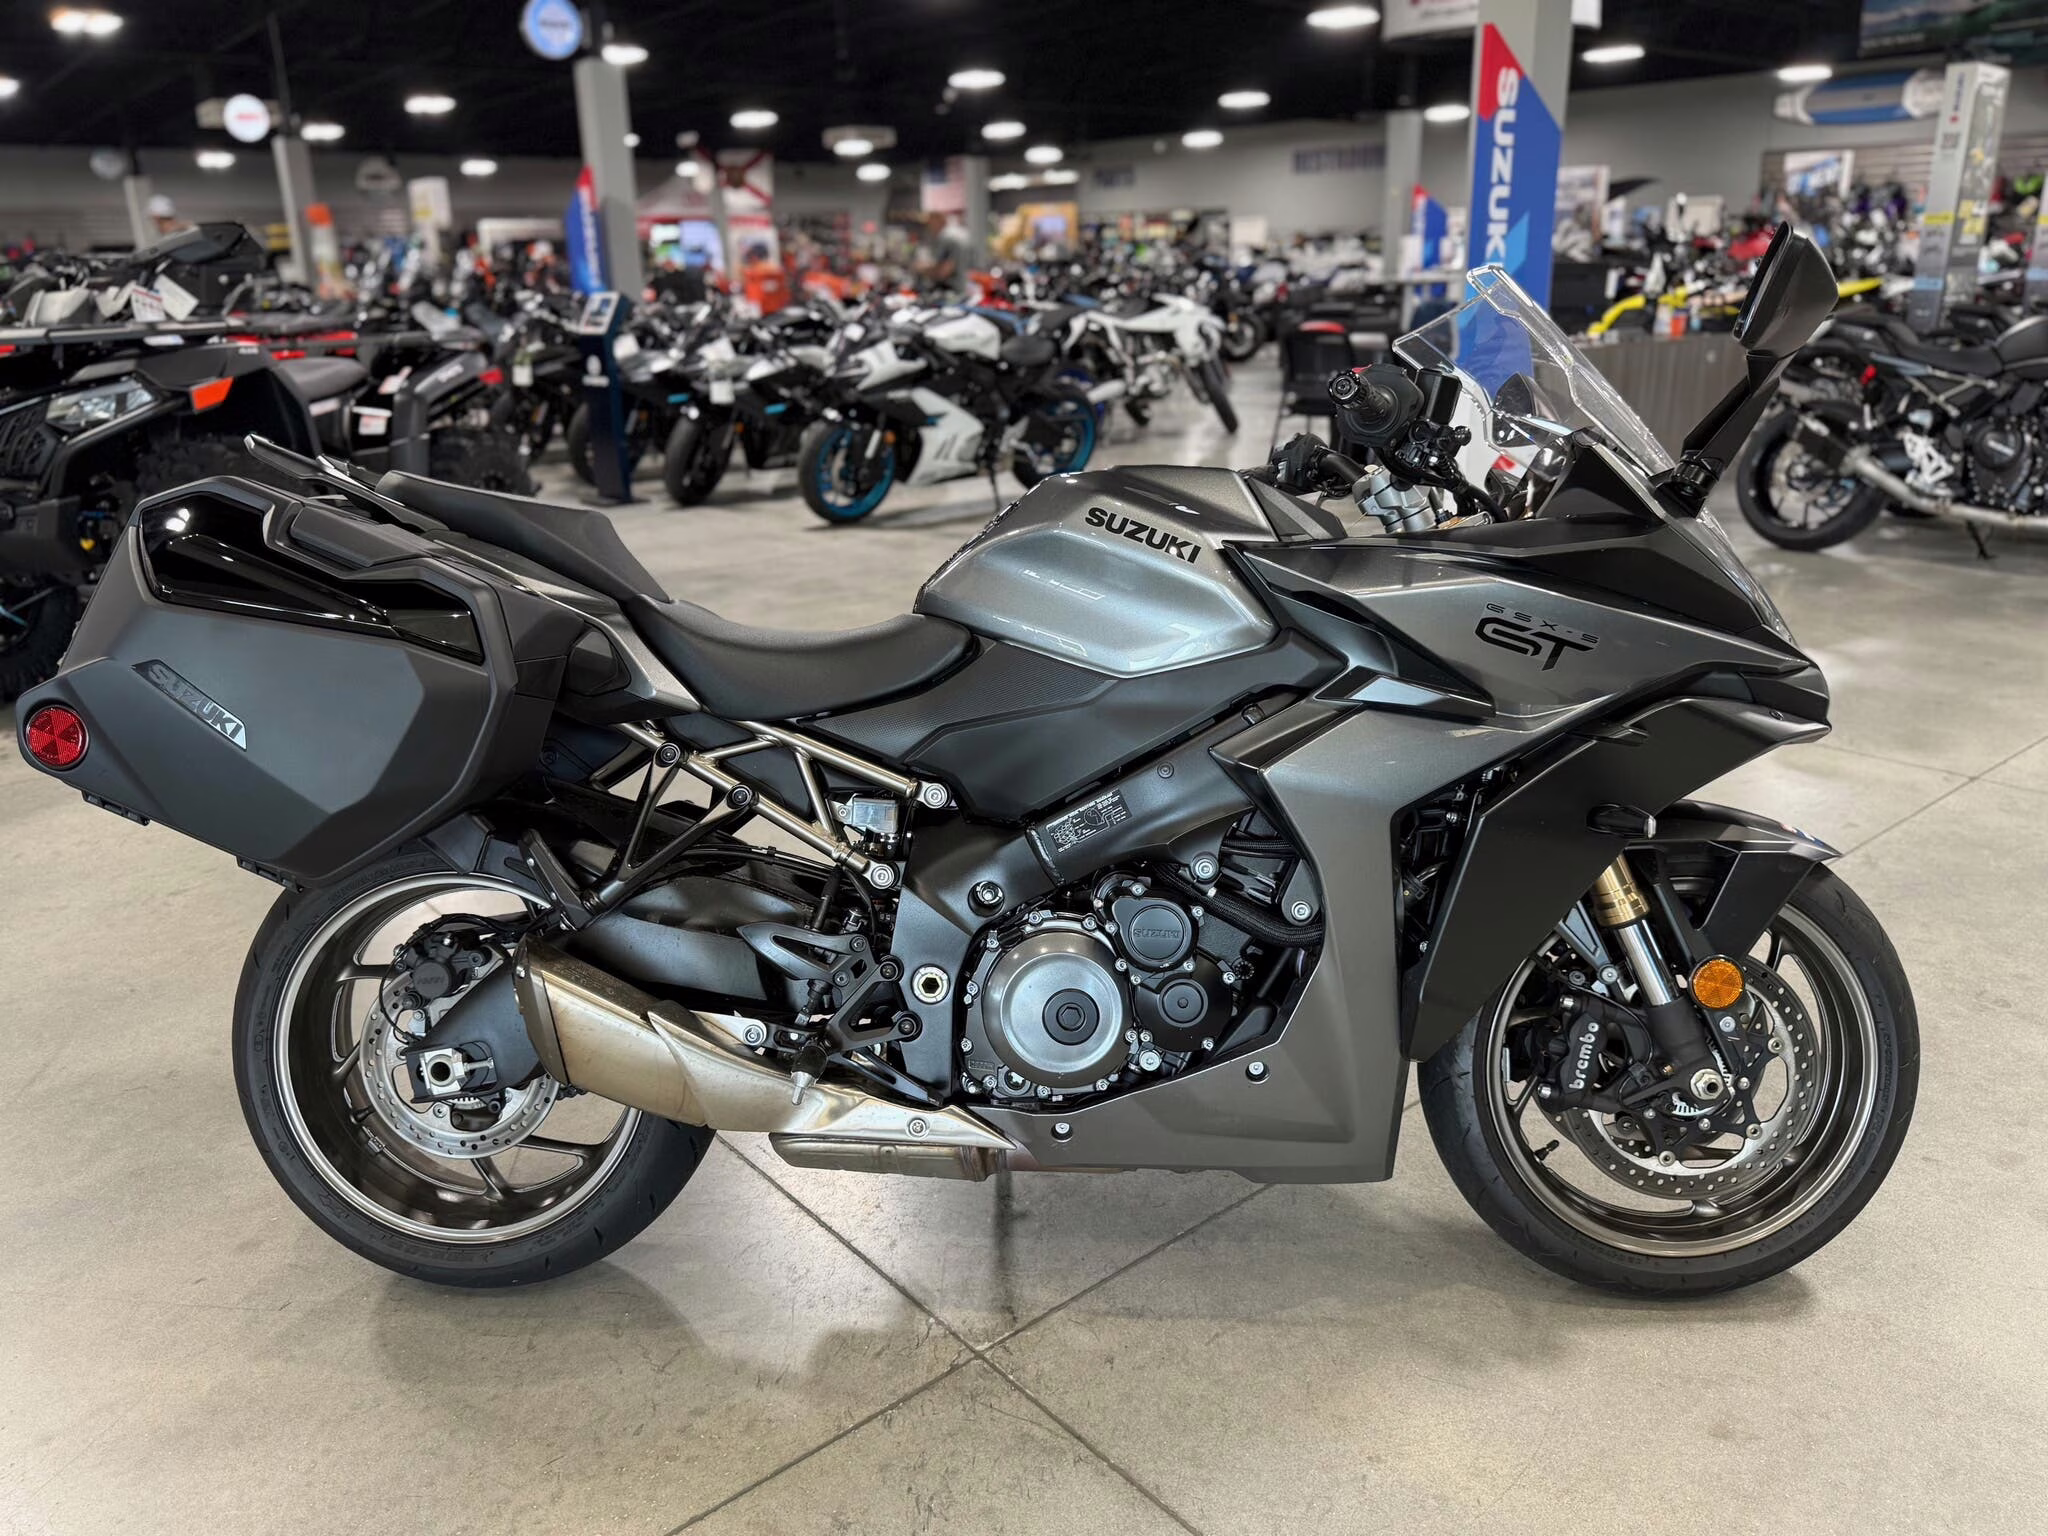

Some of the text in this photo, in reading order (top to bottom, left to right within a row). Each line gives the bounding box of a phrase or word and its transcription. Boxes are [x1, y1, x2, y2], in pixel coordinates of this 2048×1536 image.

[1085, 507, 1202, 564] SUZUKI
[1475, 617, 1595, 672] GT
[1486, 603, 1600, 644] GSX-S
[147, 663, 244, 740] SUZUKI
[1133, 928, 1180, 939] SUZUKI
[1569, 1022, 1600, 1090] brembo
